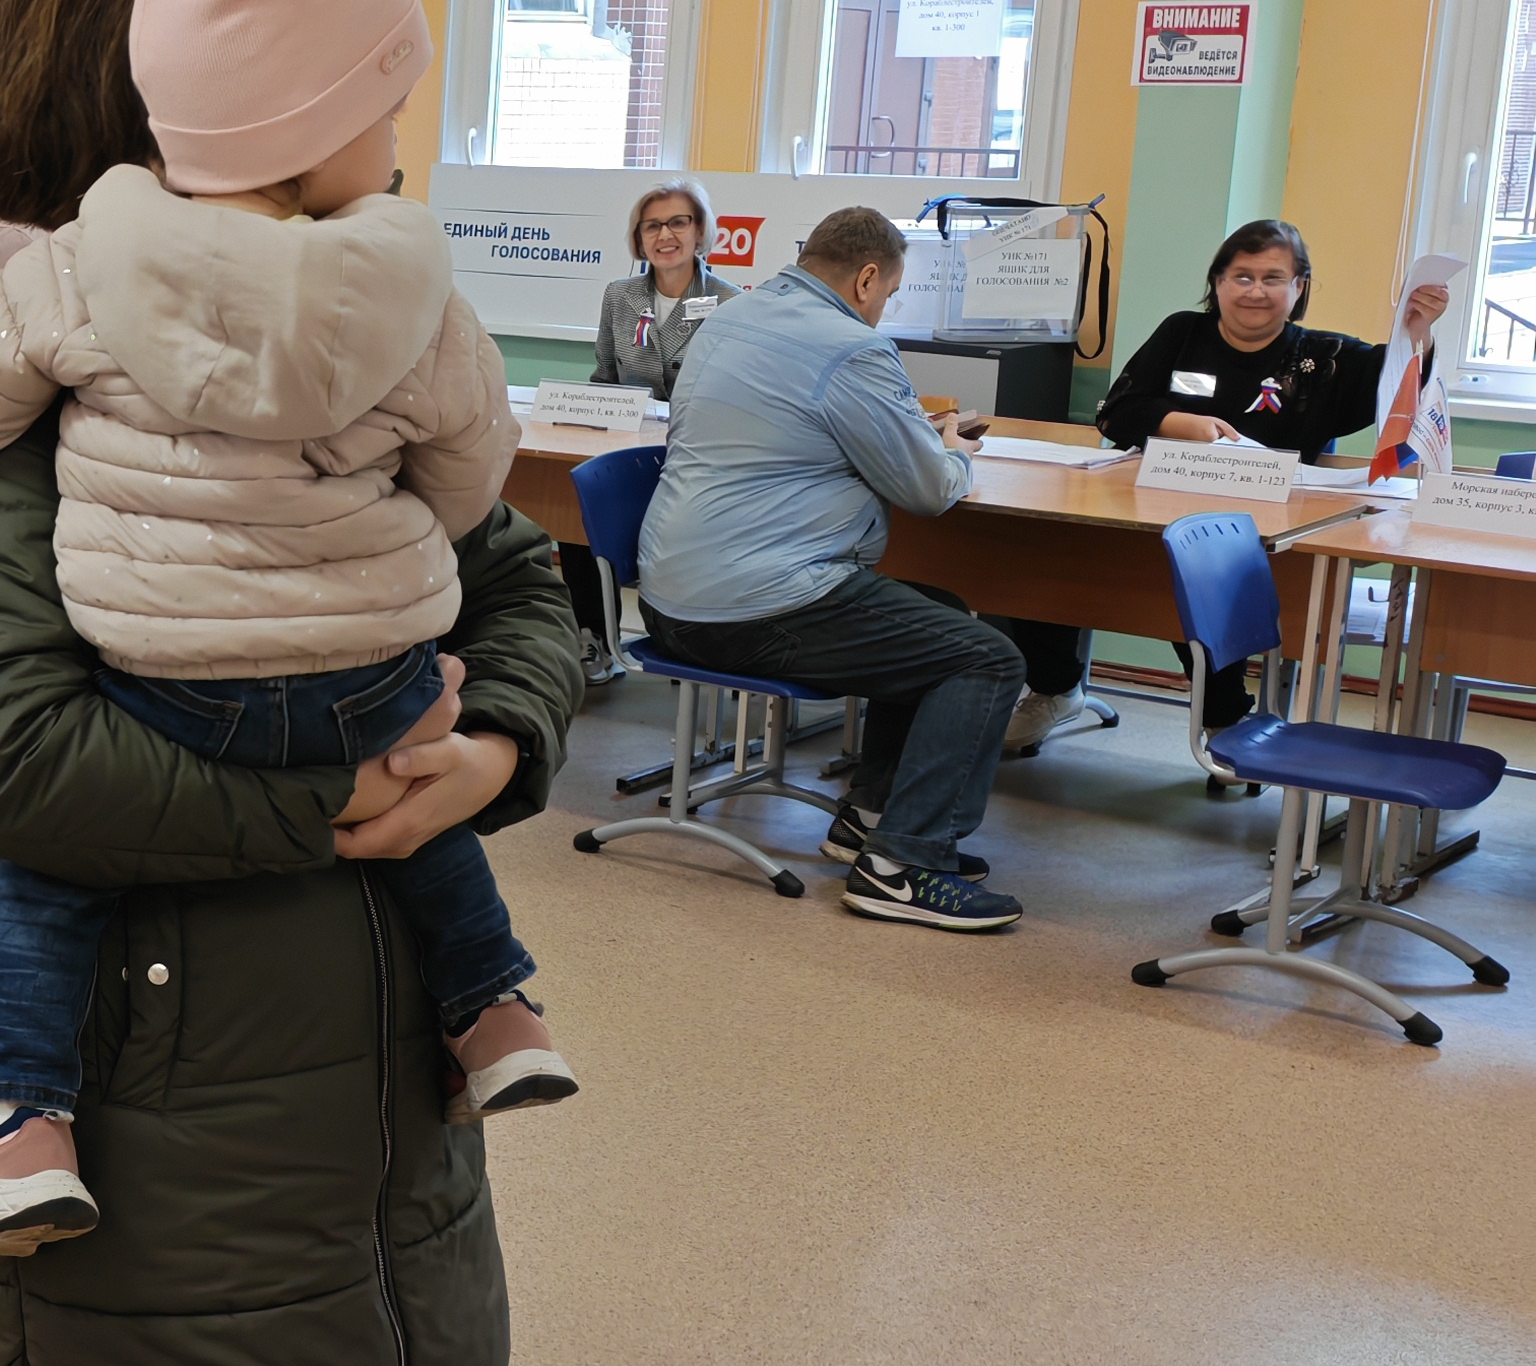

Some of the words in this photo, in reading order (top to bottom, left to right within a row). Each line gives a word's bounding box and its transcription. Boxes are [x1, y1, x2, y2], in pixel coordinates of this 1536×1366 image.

[1152, 8, 1241, 29] ВНИМАНИЕ
[1198, 48, 1238, 61] ВЕДЁТСЯ
[1147, 65, 1236, 77] ВИДЕОНАБЛЮДЕНИЕ
[443, 222, 509, 239] ЕДИНЫЙ
[511, 227, 550, 242] ДЕНЬ
[491, 245, 602, 264] ГОЛОСОВАНИЯ
[1001, 252, 1023, 261] УИК
[1023, 252, 1047, 261] №171
[997, 265, 1028, 275] ЯЩИК
[1029, 265, 1050, 274] ДЛЯ
[976, 277, 1049, 286] ГОЛОСОВАНИЯ
[1053, 278, 1069, 286] №2
[562, 391, 636, 405] Кораблестроителей,
[556, 404, 566, 413] 40,
[569, 407, 594, 415] корпус
[618, 410, 639, 418] 1-300
[1162, 452, 1177, 461] ул.
[1180, 451, 1281, 470] Кораблестроителей,
[1150, 466, 1171, 474] дом
[1173, 467, 1188, 477] 40,
[1190, 470, 1226, 482] корпус
[1229, 472, 1237, 482] 7,
[1240, 475, 1254, 483] кв.
[1258, 475, 1285, 486] 1-123
[1452, 481, 1499, 494] Морская
[1432, 497, 1454, 505] дом
[1456, 497, 1471, 508] 35,
[1475, 501, 1513, 513] корпус
[1515, 504, 1524, 514] 3,
